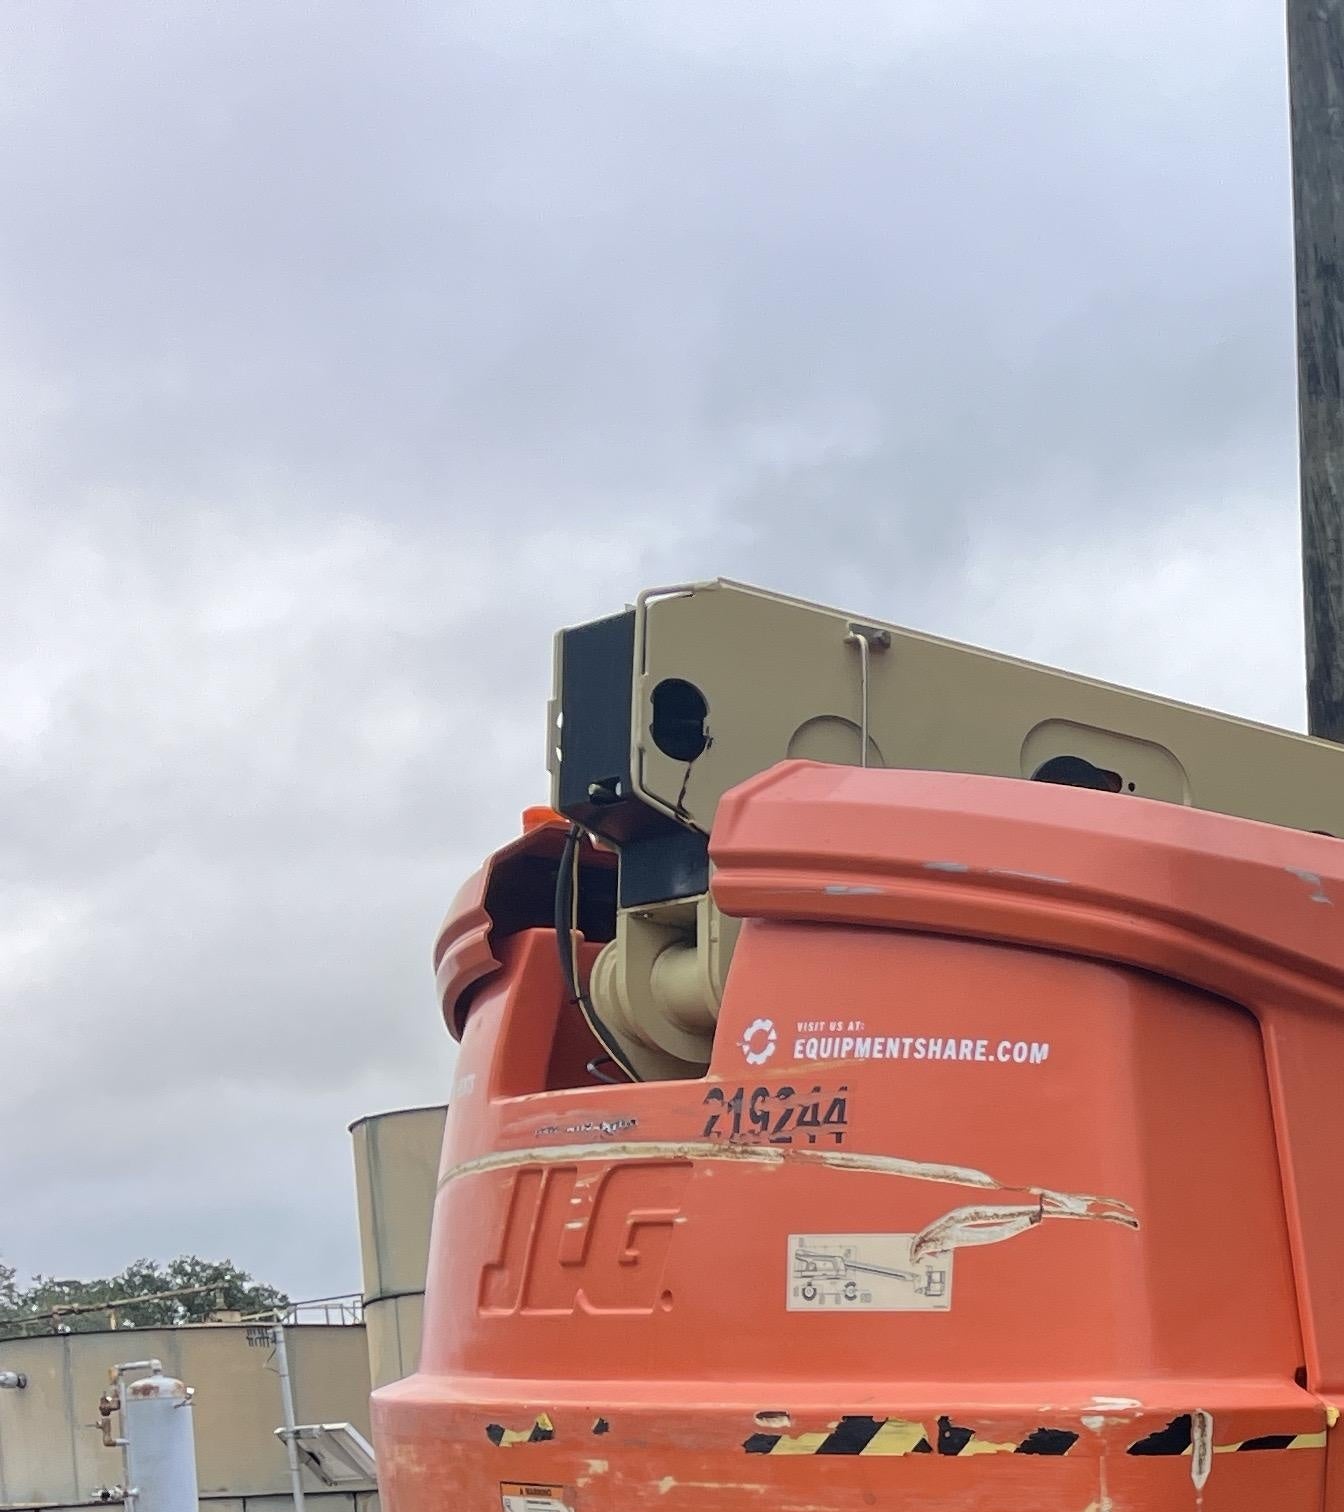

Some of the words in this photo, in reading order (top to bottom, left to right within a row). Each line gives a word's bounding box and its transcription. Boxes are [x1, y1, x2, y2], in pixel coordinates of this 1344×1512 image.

[797, 1021, 825, 1032] VISIT
[829, 1021, 843, 1031] US
[848, 1021, 865, 1032] AT:
[793, 1037, 1050, 1064] EQUIPMENTSHARE.COM
[701, 1086, 848, 1144] 219244
